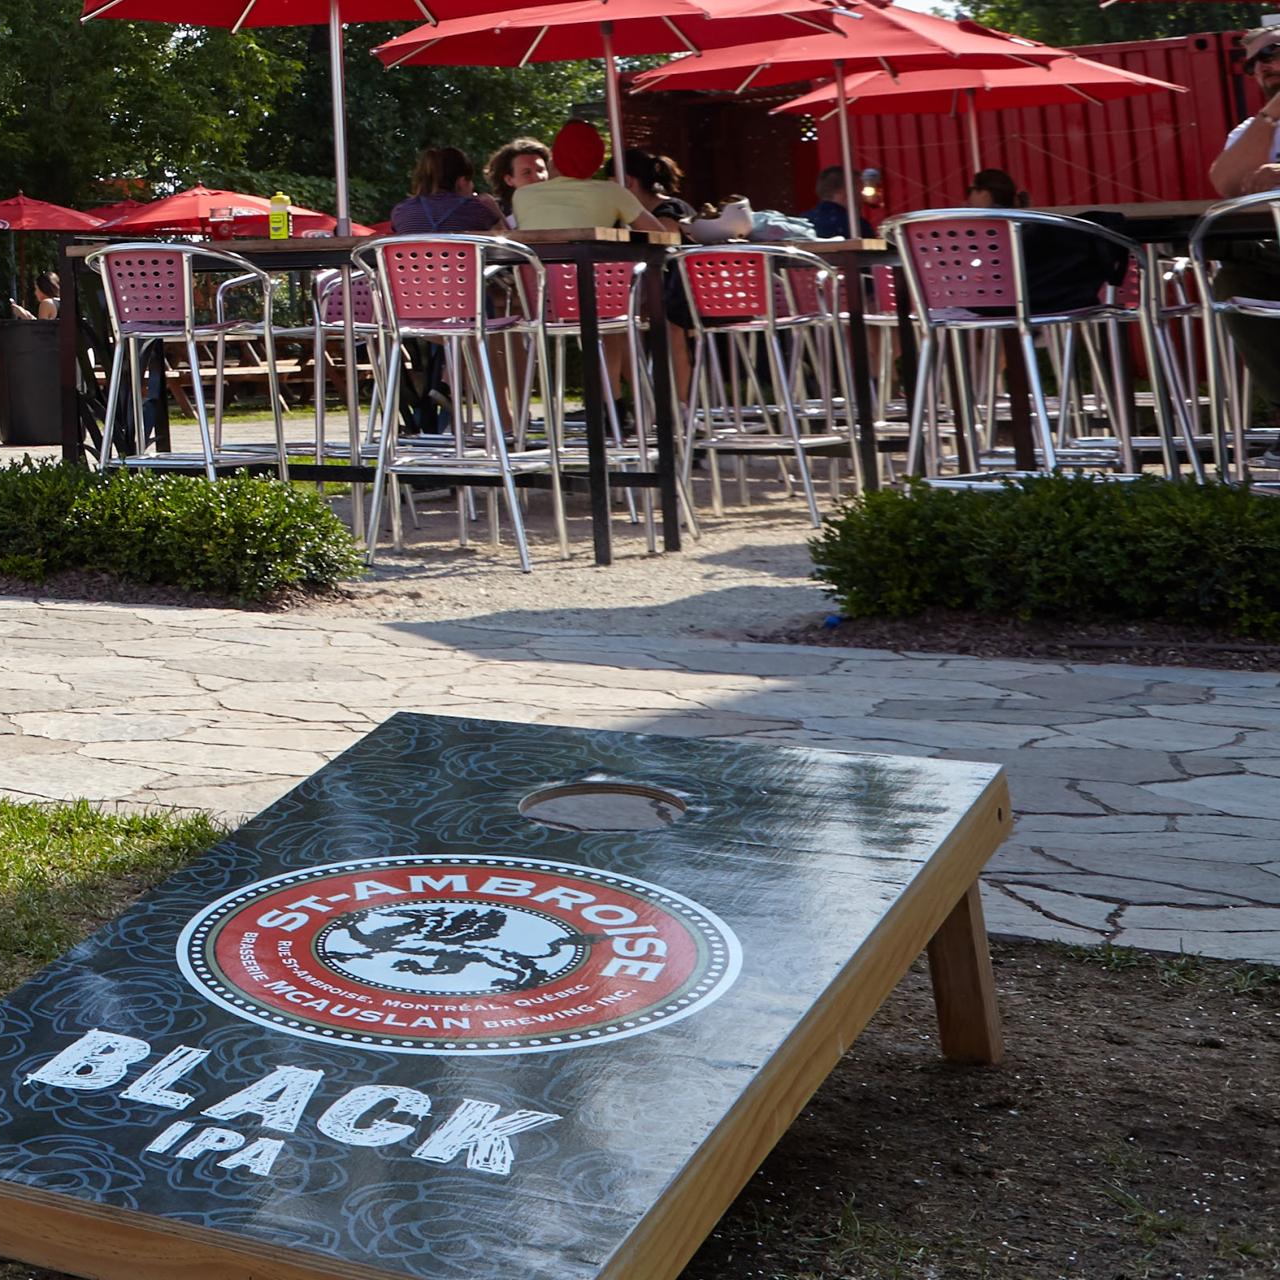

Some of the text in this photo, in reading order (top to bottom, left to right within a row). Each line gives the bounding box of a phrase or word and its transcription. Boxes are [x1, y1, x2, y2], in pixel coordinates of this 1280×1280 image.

[256, 874, 668, 983] ST-AMBROISE
[278, 940, 590, 1012] RUE ST-AMBROISE, MONTRÉAL, QUÉBEC
[239, 931, 638, 1030] BRASSERIE MCAUSLAN BREWING INC.
[22, 1028, 564, 1176] BLACK
[145, 1120, 285, 1177] IPA
